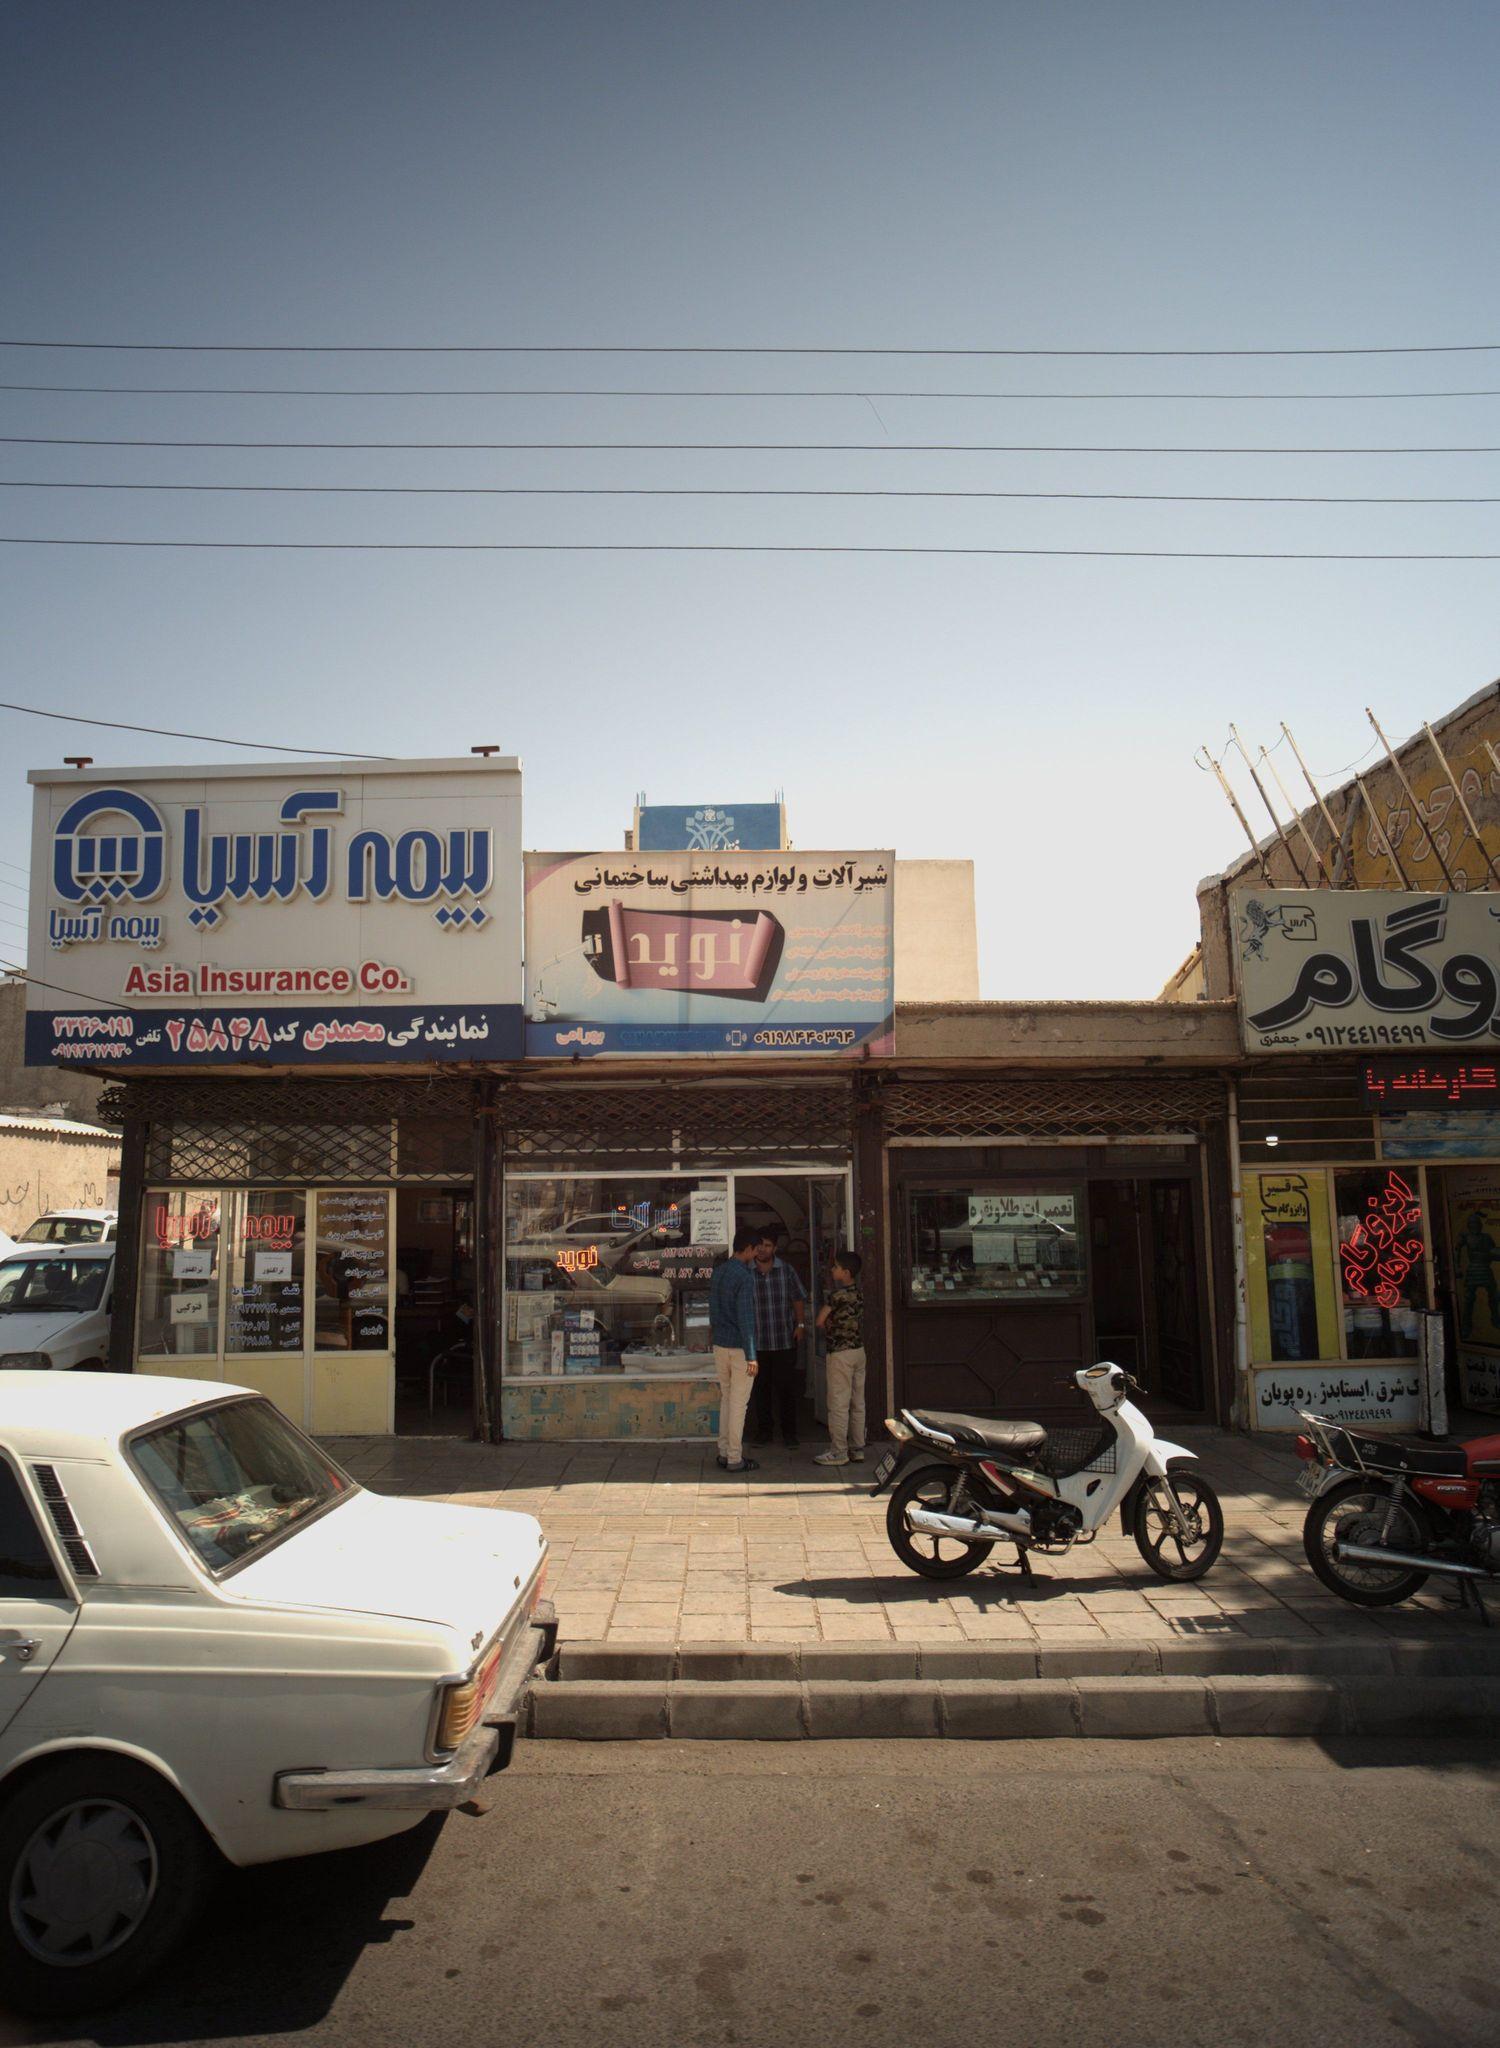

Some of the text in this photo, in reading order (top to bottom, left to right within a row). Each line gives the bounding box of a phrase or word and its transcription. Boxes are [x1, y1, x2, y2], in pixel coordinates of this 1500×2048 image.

[182, 788, 494, 931] بیمه آسیا
[574, 865, 669, 894] ساختمانی
[670, 864, 749, 895] بهداشتی
[751, 865, 794, 897] لوازم
[48, 905, 162, 950] بیمه آسیا
[627, 918, 745, 981] نوید
[125, 961, 409, 994] Asia Insurance Co.
[1247, 897, 1500, 1040] وگام
[135, 1028, 162, 1046] تلفن
[165, 1015, 272, 1053] ۲۵۸۴۸
[272, 1021, 300, 1043] کد
[302, 1018, 385, 1052] محمدی
[386, 1014, 490, 1049] نمایندگی
[754, 1029, 856, 1045] ۰۹۱۹۸۴۴۰۳۹۴
[1259, 1033, 1301, 1047] جعفری
[154, 1198, 296, 1250] بیمه آسیا
[654, 1202, 682, 1233] شیر
[556, 1245, 599, 1272] نوید
[1376, 1378, 1404, 1403] شرق
